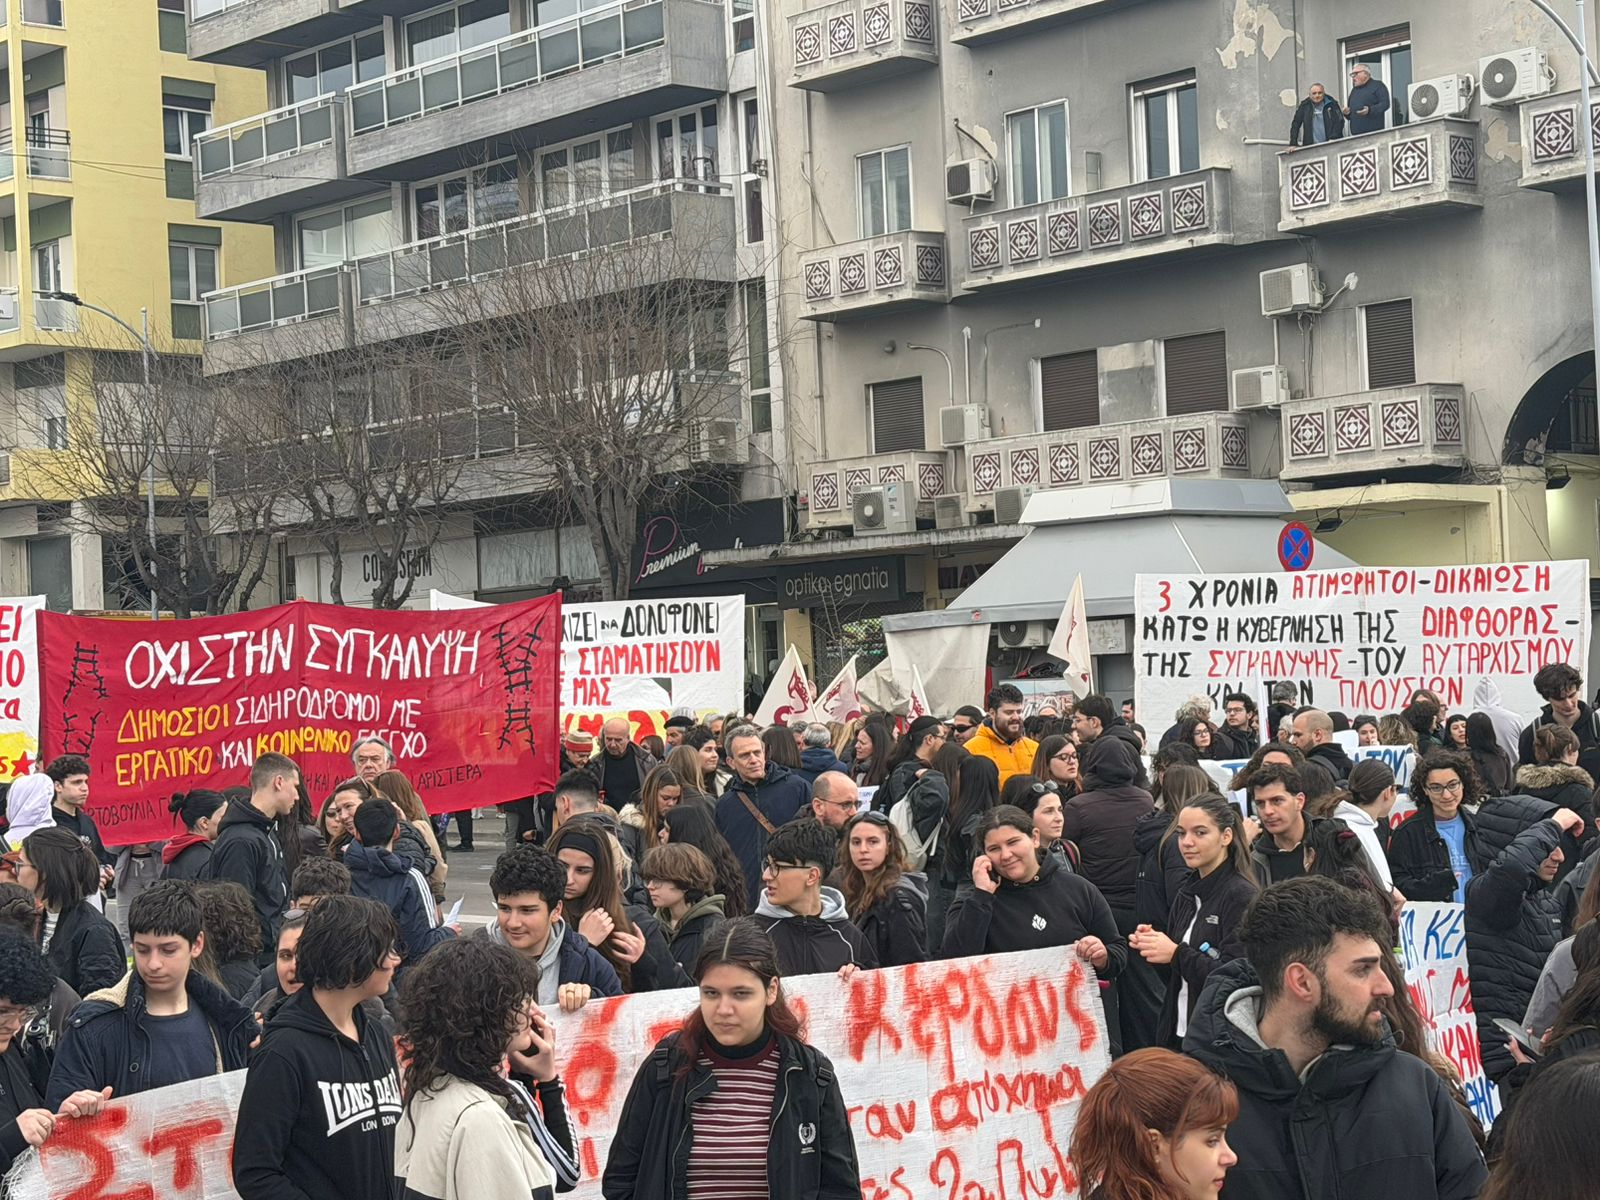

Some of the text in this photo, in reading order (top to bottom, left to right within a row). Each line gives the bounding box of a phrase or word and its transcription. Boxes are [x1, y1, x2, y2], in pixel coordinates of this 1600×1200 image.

[785, 566, 889, 600] optika egnatia
[1158, 580, 1172, 613] 3
[1188, 576, 1278, 609] ΧΡΟΝΙΑ
[620, 602, 720, 638] ΔΟΛΟΦΟΝΕΙ
[1143, 615, 1208, 642] ΚΑΤΩ
[1216, 616, 1229, 643] Η
[1237, 614, 1344, 643] ΚΥΒΕΡΝΗΣΗ
[1353, 609, 1400, 643] ΤΗΣ
[305, 623, 482, 681] ΣΥΓΚΑΛΥΨΗ
[578, 639, 721, 676] ΣΤΑΜΑΤΗΣΟΥΝ
[1142, 652, 1192, 678] ΤΗΣ
[1423, 637, 1574, 676] ΑΥΤΑΡΧΙΣΜΟΥ
[572, 677, 612, 707] ΜΑΣ
[1263, 679, 1314, 706] ΤΝ
[117, 686, 422, 744] ΔΗΜΟΣΙΟΙ ΣΙΔΗΡΟΔΡΟΜΟΙ ΜΕ
[115, 745, 213, 786] ΕΡΓΑΤΙΚΟ
[220, 737, 253, 770] ΚΑΙ
[256, 726, 352, 756] ΚΟΙΝΩΝΙΚΟ
[417, 763, 482, 790] ΑΡΙΣΤΕΡΑ
